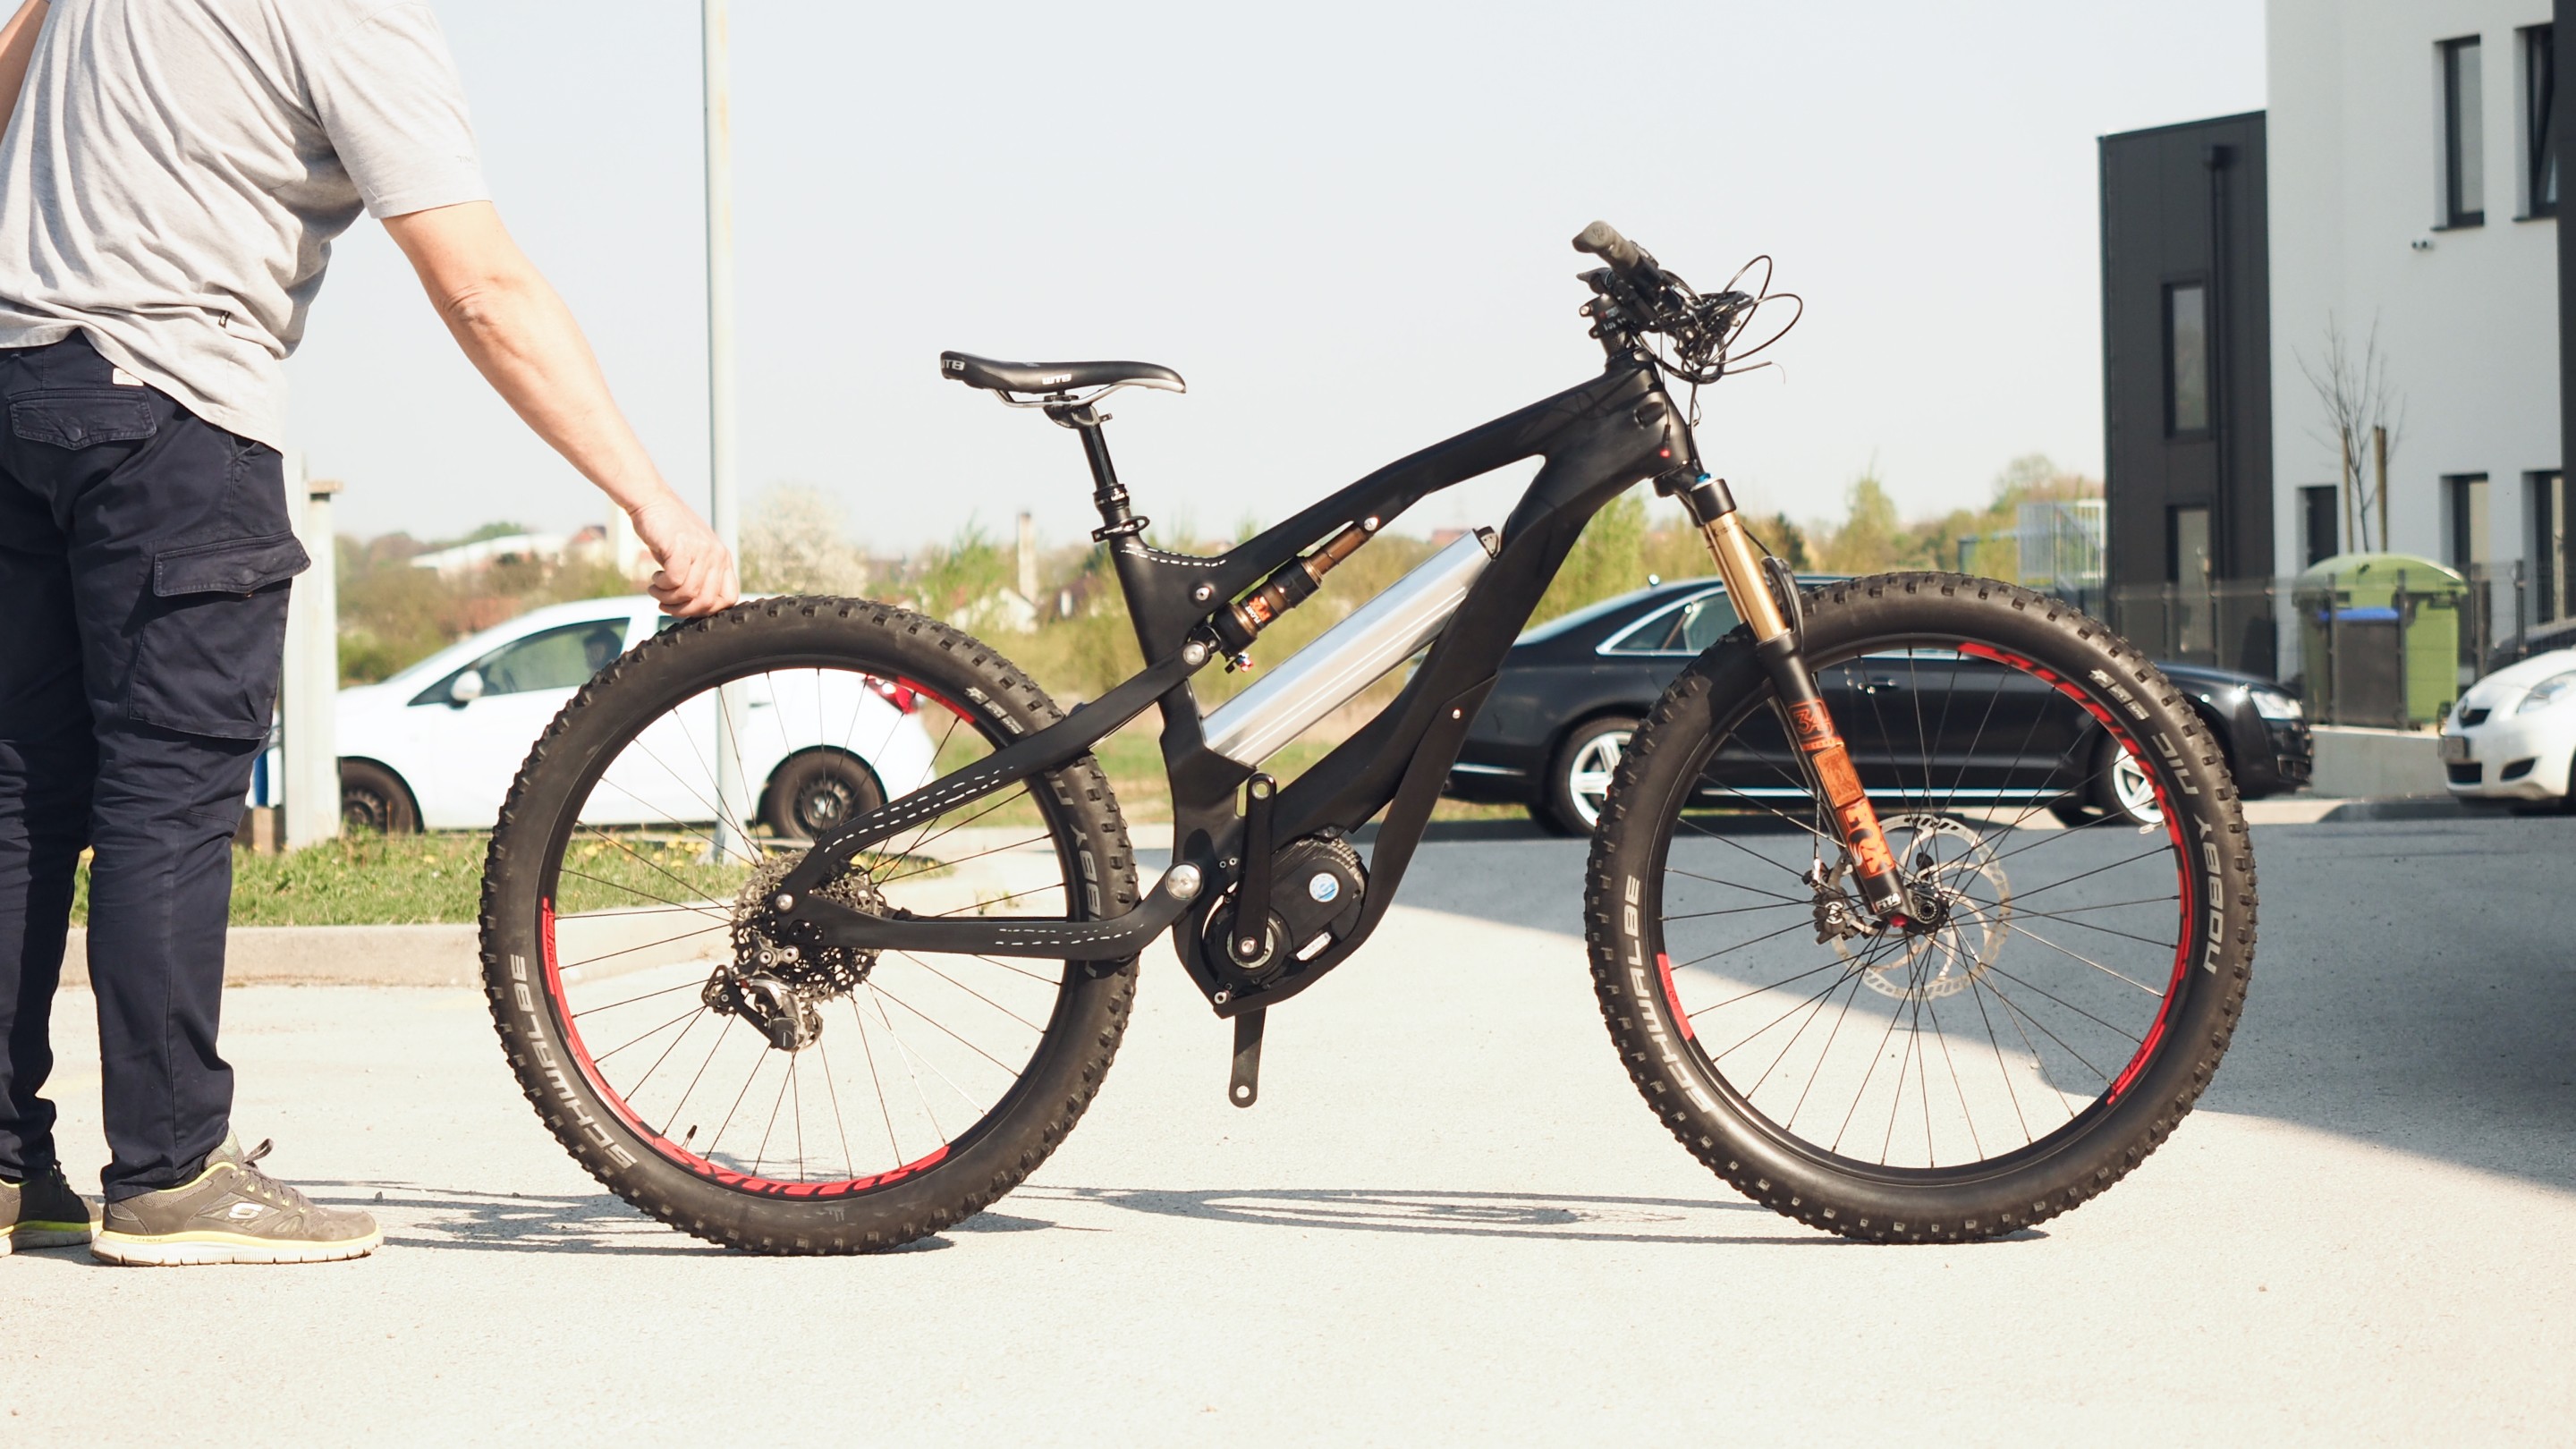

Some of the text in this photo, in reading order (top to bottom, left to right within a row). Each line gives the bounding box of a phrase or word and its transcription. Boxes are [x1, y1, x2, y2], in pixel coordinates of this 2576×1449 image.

[1042, 374, 1072, 385] WTB
[2151, 733, 2224, 975] NOBBY NIC
[510, 953, 638, 1169] SCHWALBE
[1623, 874, 1716, 1113] SCHWALBE
